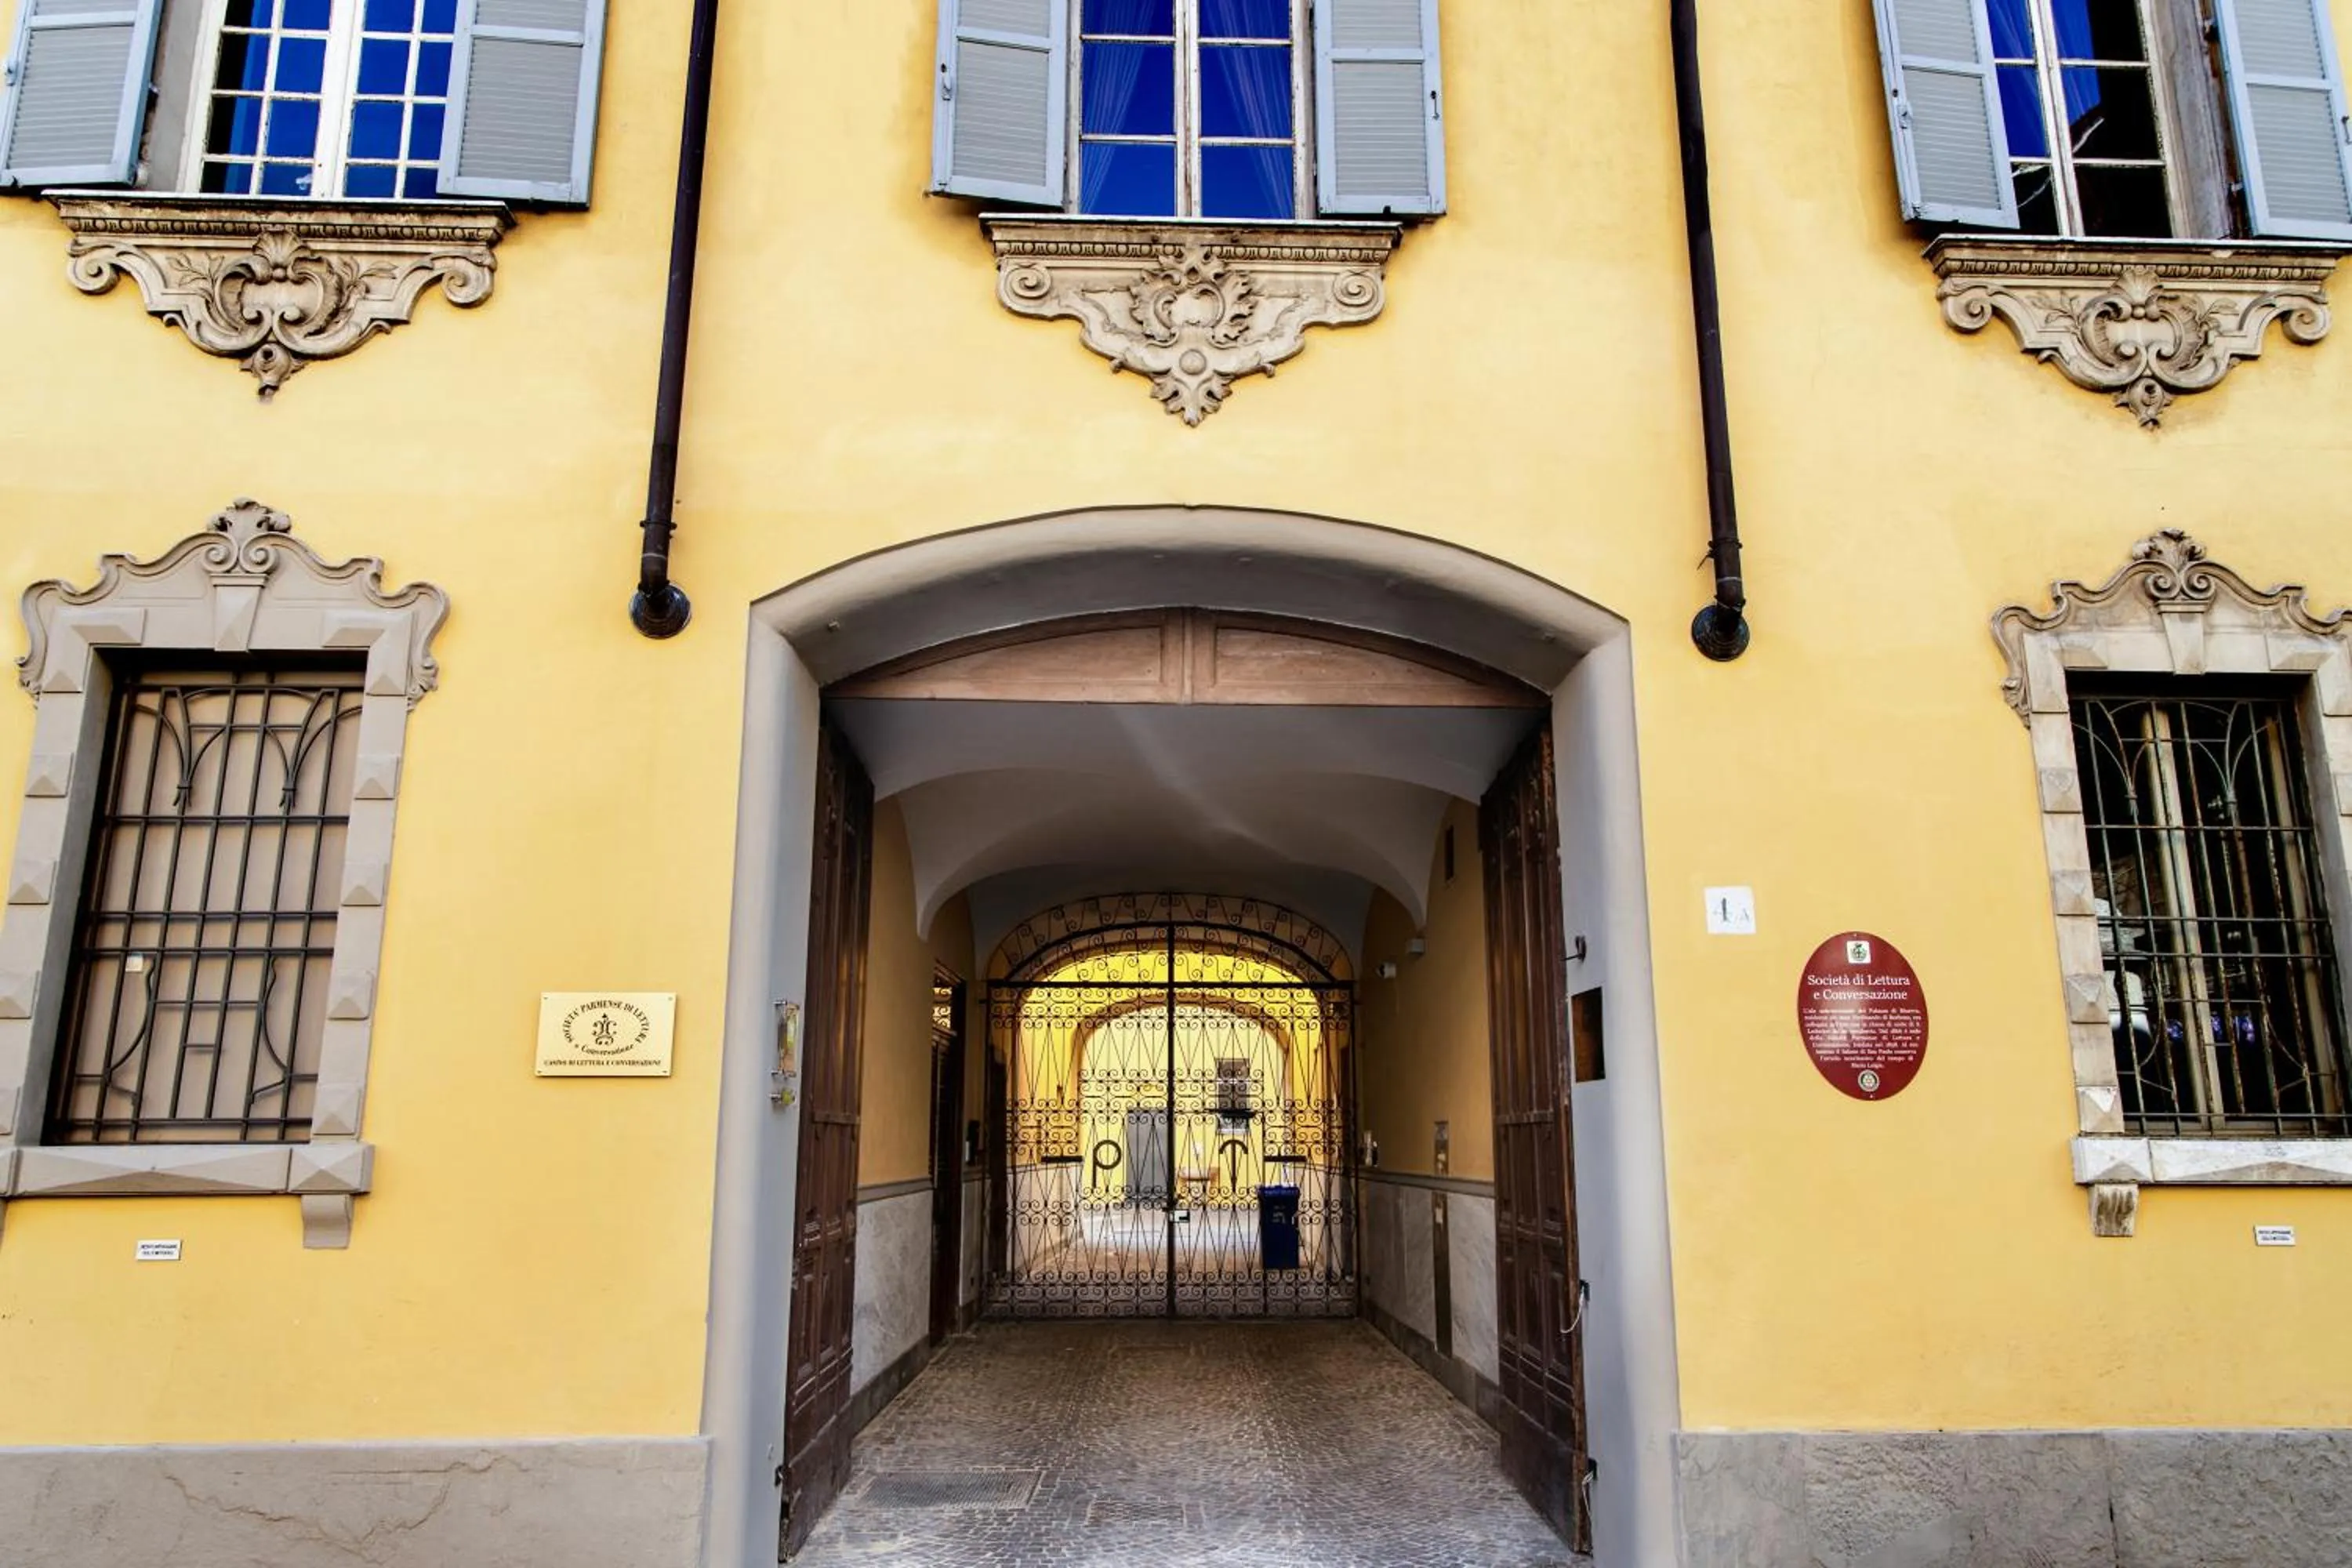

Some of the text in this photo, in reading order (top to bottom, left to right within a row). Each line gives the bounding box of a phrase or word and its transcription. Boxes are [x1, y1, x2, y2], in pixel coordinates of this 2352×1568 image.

[1807, 974, 1911, 985] Società di Lettura
[1813, 989, 1907, 1000] e Conversazione
